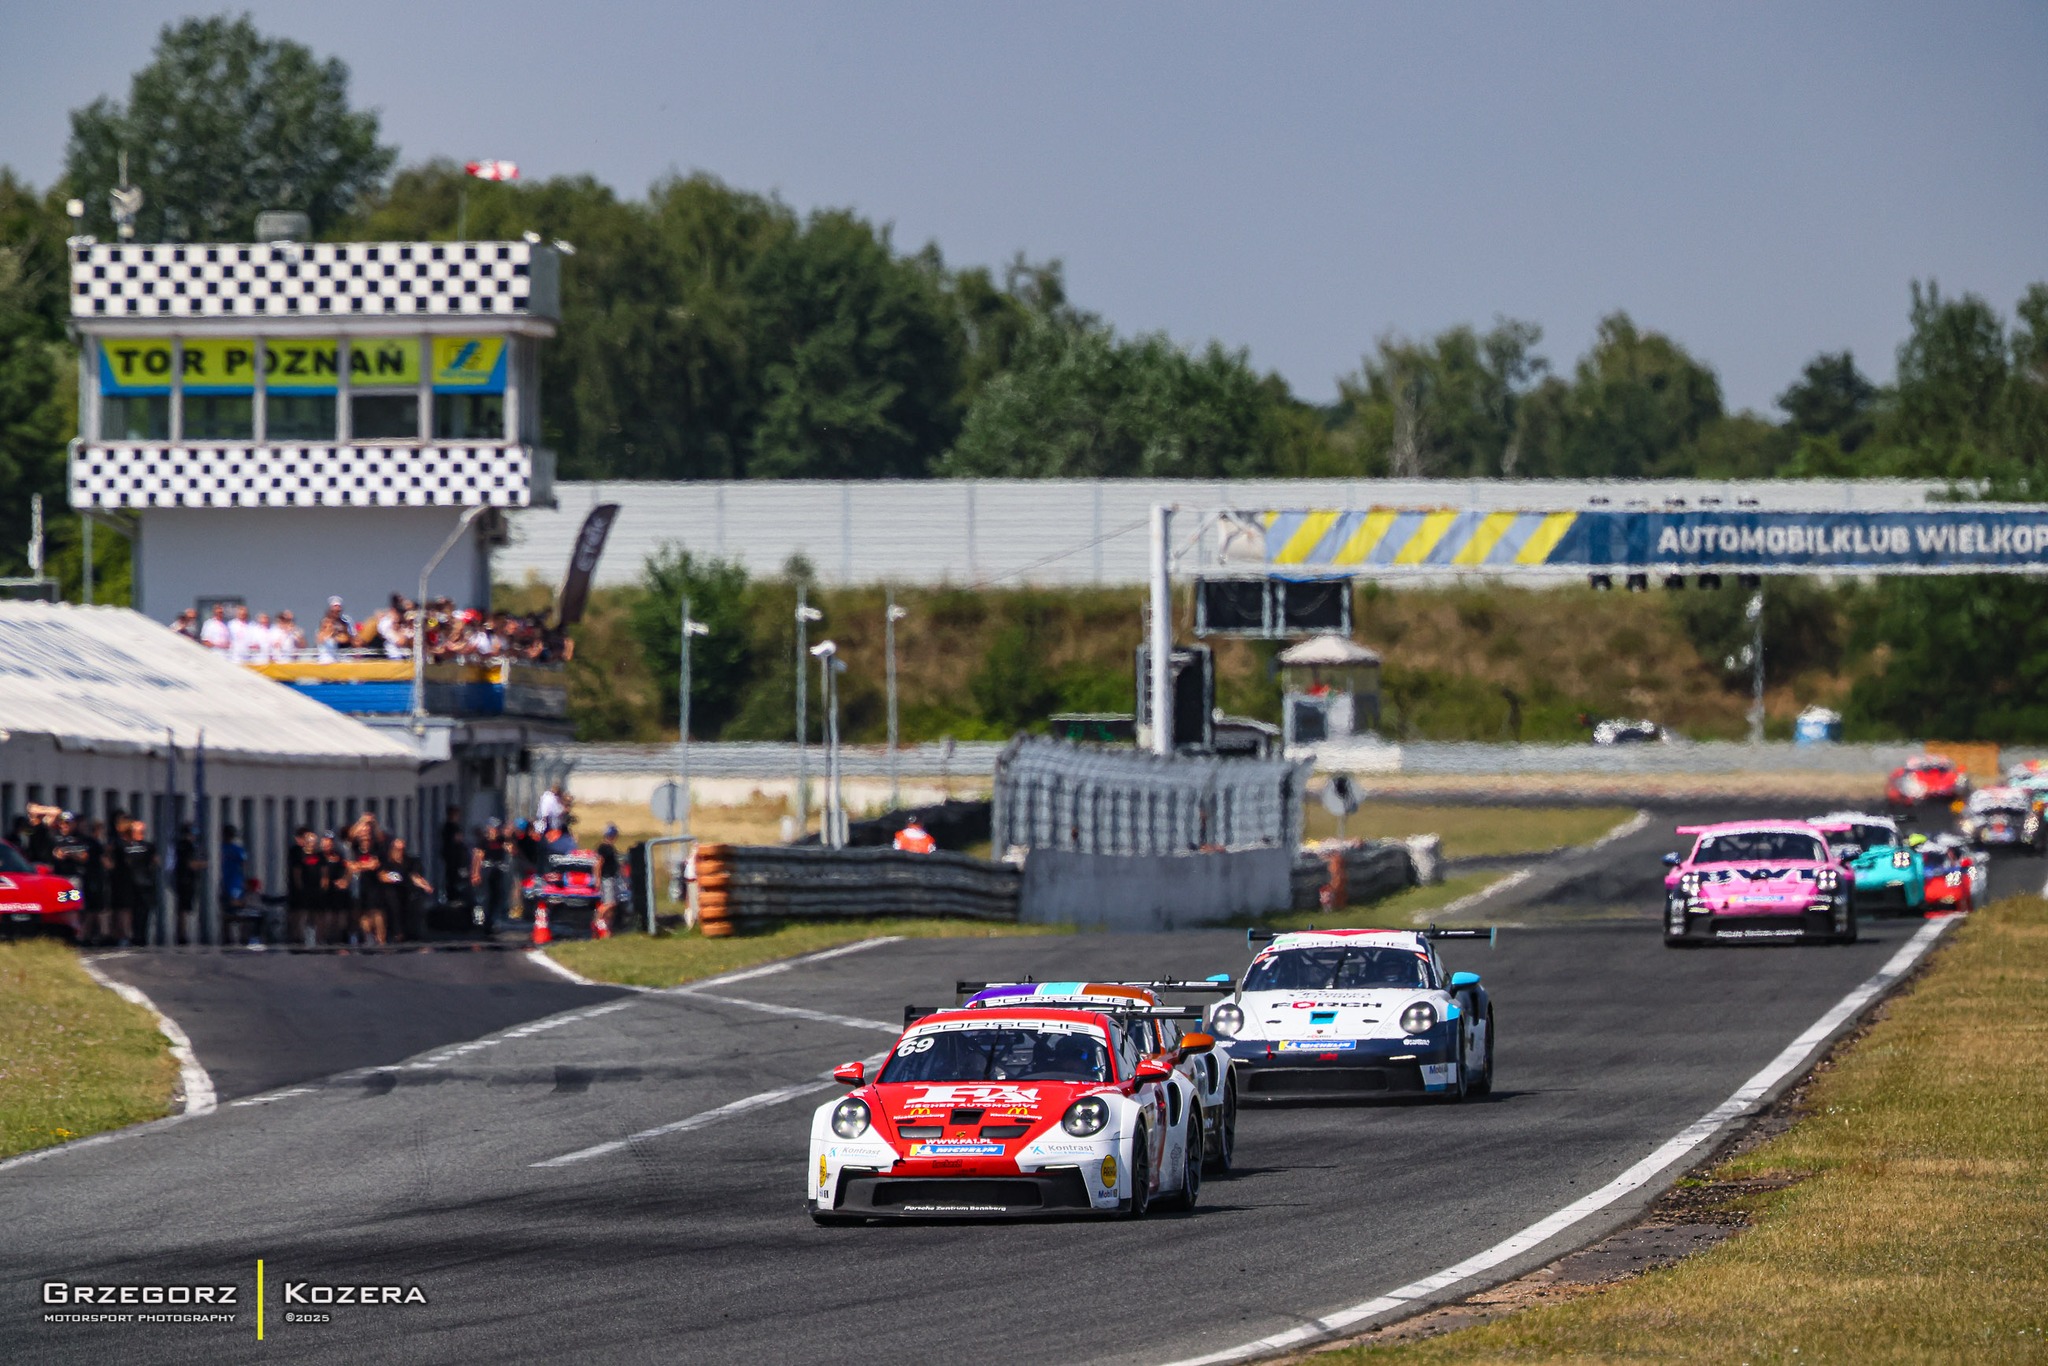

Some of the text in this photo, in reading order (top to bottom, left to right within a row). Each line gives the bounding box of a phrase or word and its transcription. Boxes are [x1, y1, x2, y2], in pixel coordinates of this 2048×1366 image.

[115, 349, 205, 376] TOR
[1657, 524, 1911, 555] AUTOMOBILKLUB
[988, 996, 1127, 1006] PORSCHE
[919, 1021, 1089, 1034] PORSCHE
[897, 1037, 934, 1057] 69
[842, 1146, 881, 1155] Kontrast
[1048, 1144, 1095, 1152] Kontrast
[1098, 1190, 1113, 1198] Mobil
